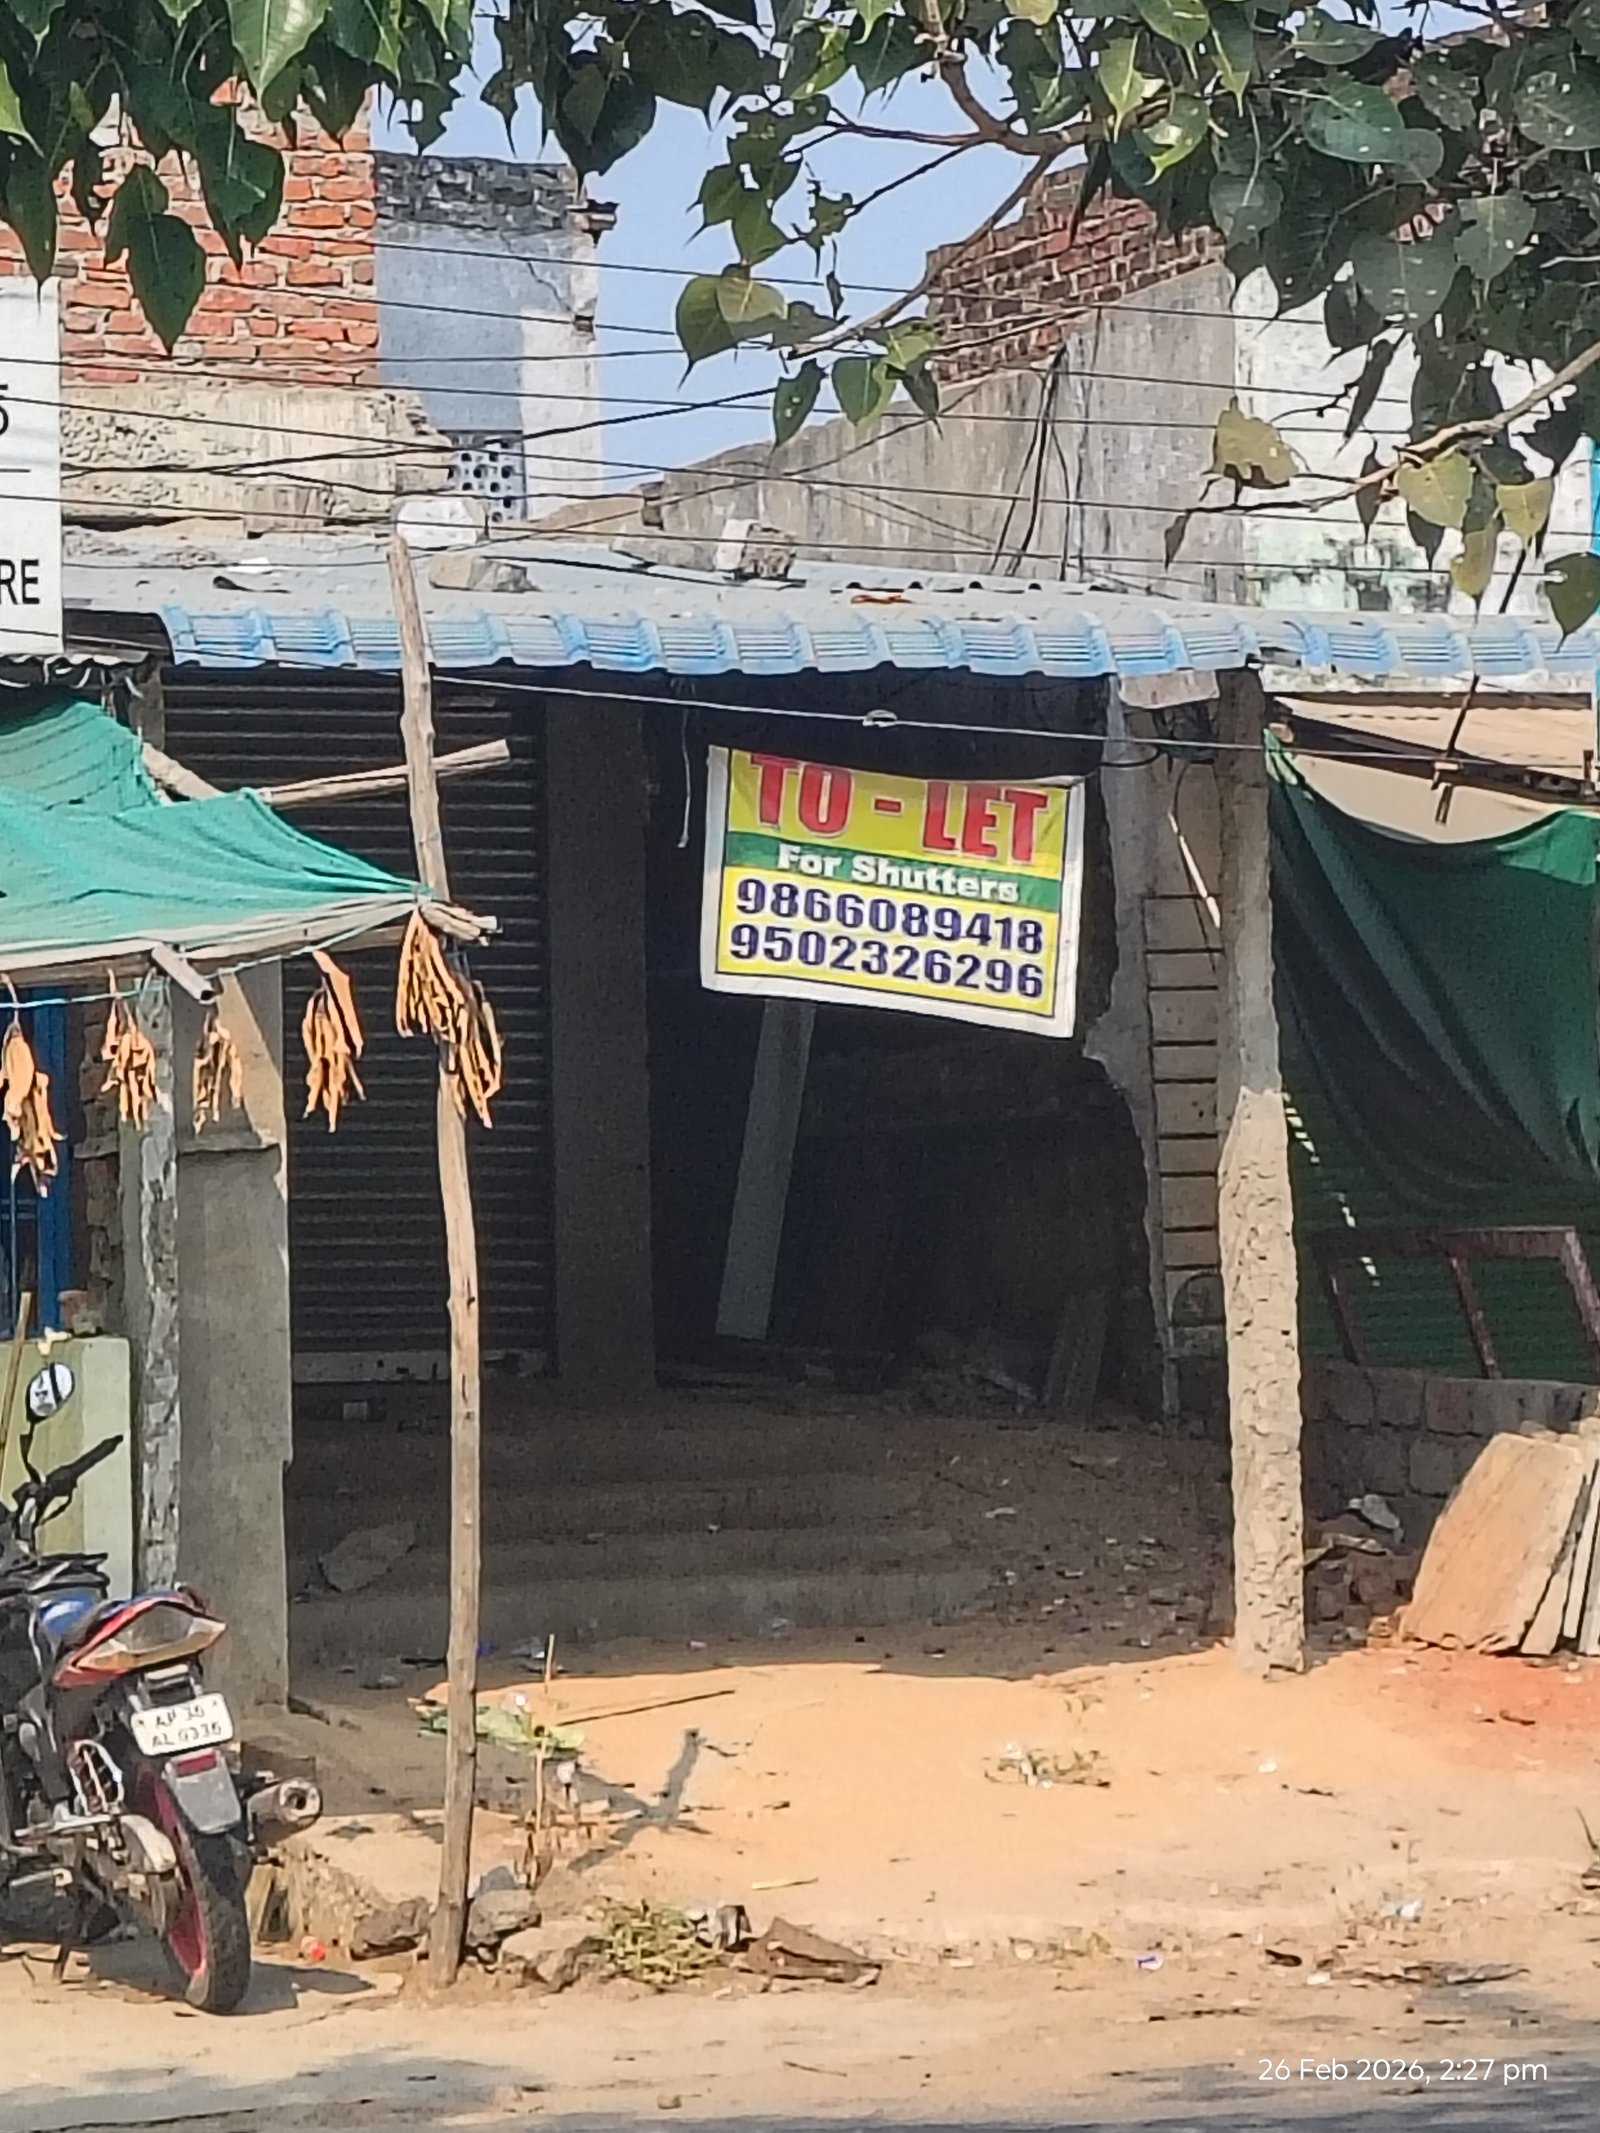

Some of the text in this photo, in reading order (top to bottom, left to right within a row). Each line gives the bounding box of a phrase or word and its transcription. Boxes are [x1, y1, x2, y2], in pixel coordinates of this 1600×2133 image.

[750, 754, 853, 838] TO
[922, 781, 1048, 863] LET
[777, 844, 1020, 904] For Shutters
[735, 877, 1044, 955] 9866089418
[729, 923, 1044, 999] 9502326296
